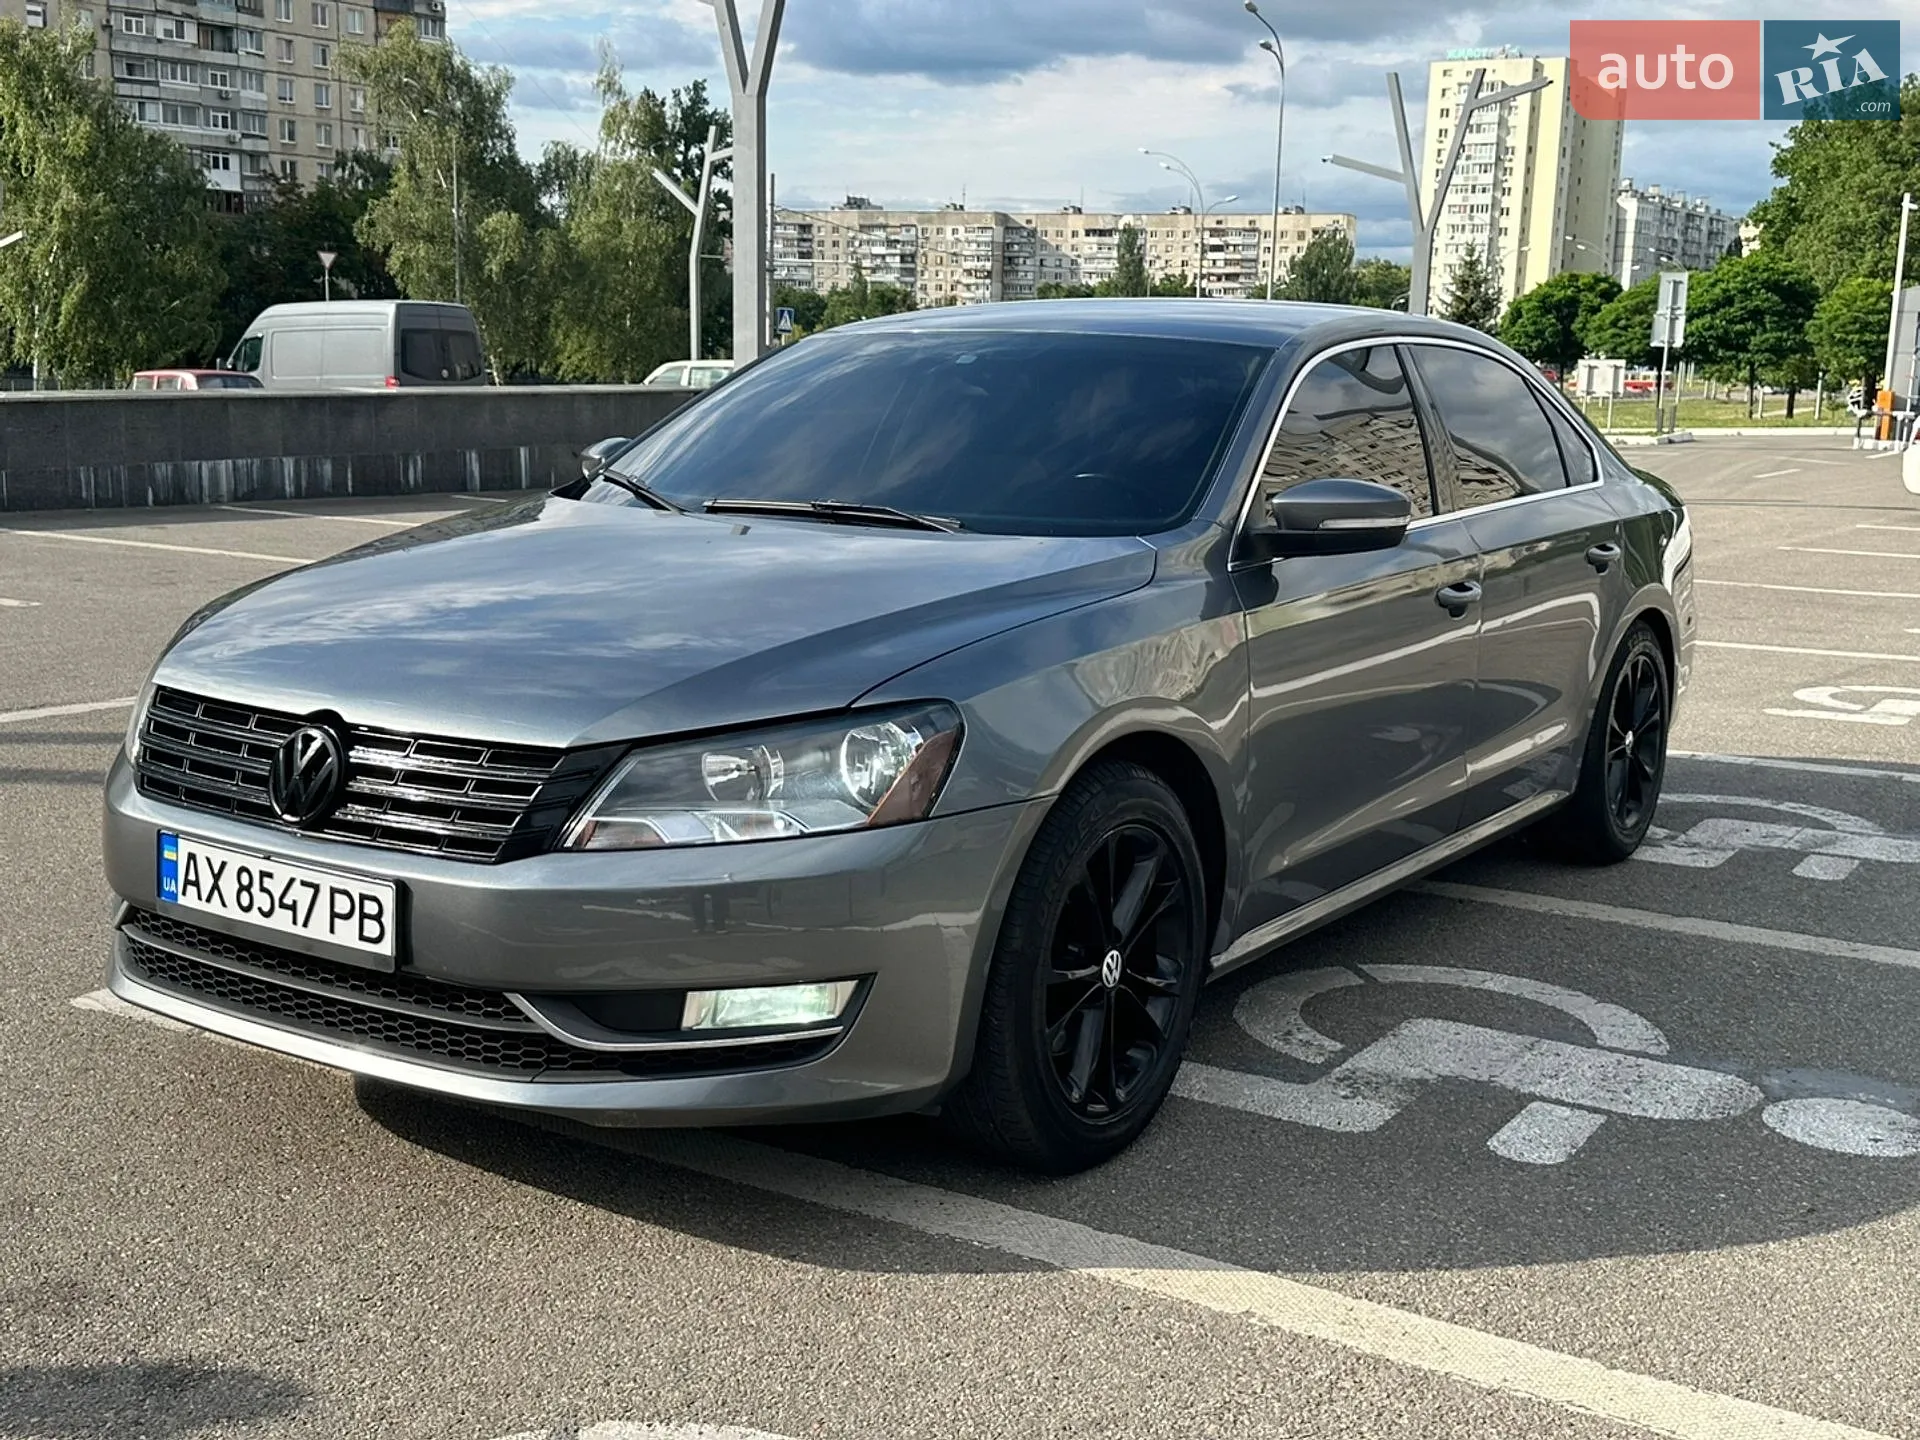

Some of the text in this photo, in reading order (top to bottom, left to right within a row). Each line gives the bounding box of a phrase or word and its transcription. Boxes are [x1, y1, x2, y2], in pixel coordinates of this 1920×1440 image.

[163, 876, 177, 894] UA
[182, 852, 386, 944] AX 8547 PB
